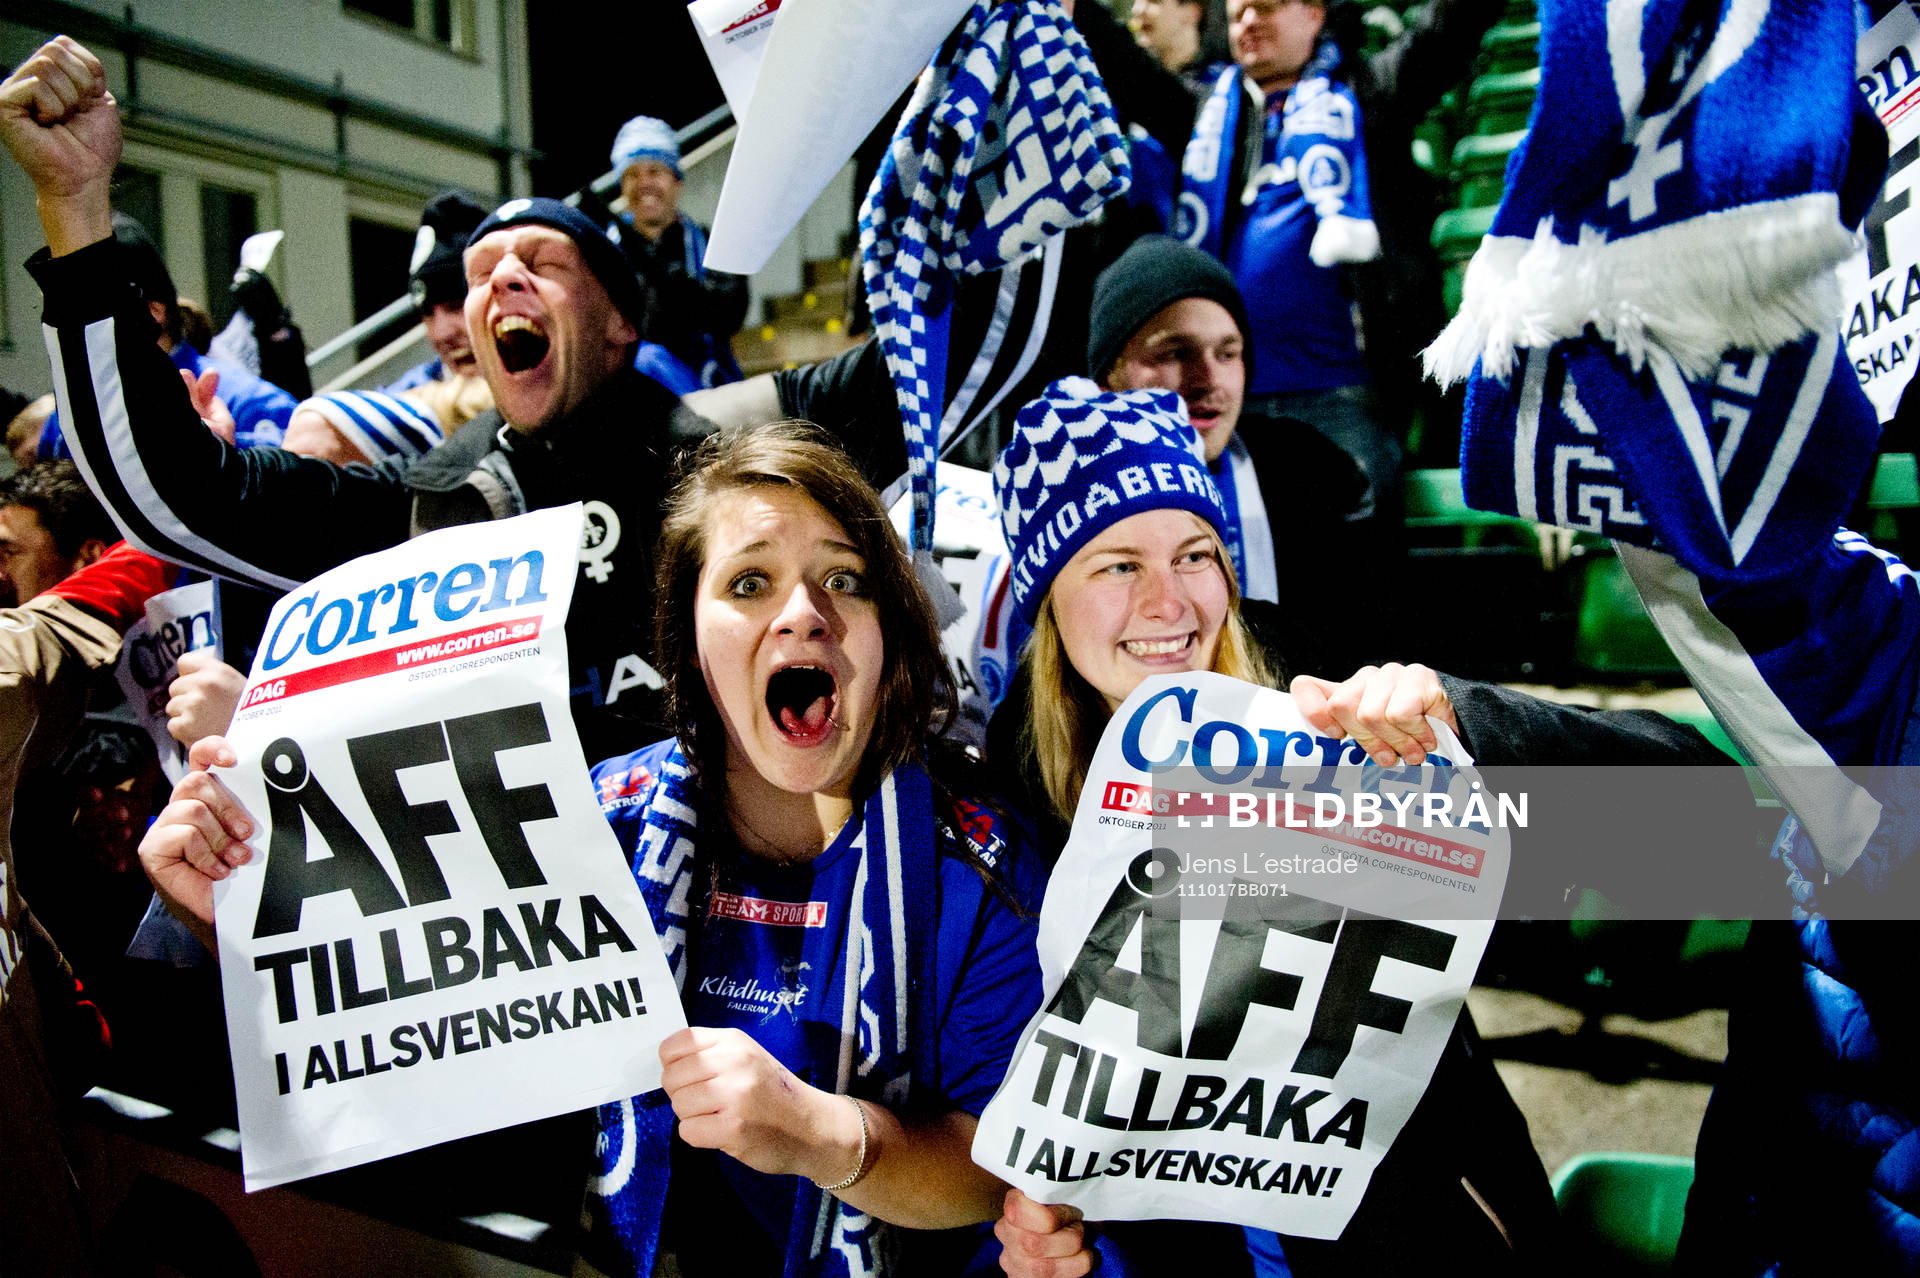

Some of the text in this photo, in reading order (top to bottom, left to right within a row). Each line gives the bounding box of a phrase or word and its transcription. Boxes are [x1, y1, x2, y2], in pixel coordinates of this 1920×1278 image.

[261, 549, 548, 671] Corren
[249, 679, 287, 705] DAG
[396, 622, 536, 666] www.corren.se
[449, 646, 541, 673] CORRESPONDENTEN
[252, 701, 560, 940] ÅFF
[1098, 815, 1167, 831] OKTOBER 2011
[1108, 786, 1117, 806] I
[1120, 787, 1171, 813] DAG
[1371, 858, 1477, 894] CORRESPONDENTEN
[253, 894, 638, 1025] TILLBAKA
[699, 975, 809, 1006] Klädhuset
[1044, 846, 1458, 1080] ÅFF
[275, 976, 648, 1096] I ALLSVENSKAN!
[727, 1001, 769, 1015] FALERUM
[1031, 1028, 1370, 1151] TILLBAKA
[1005, 1125, 1343, 1198] I ALLSVENSKAN!
